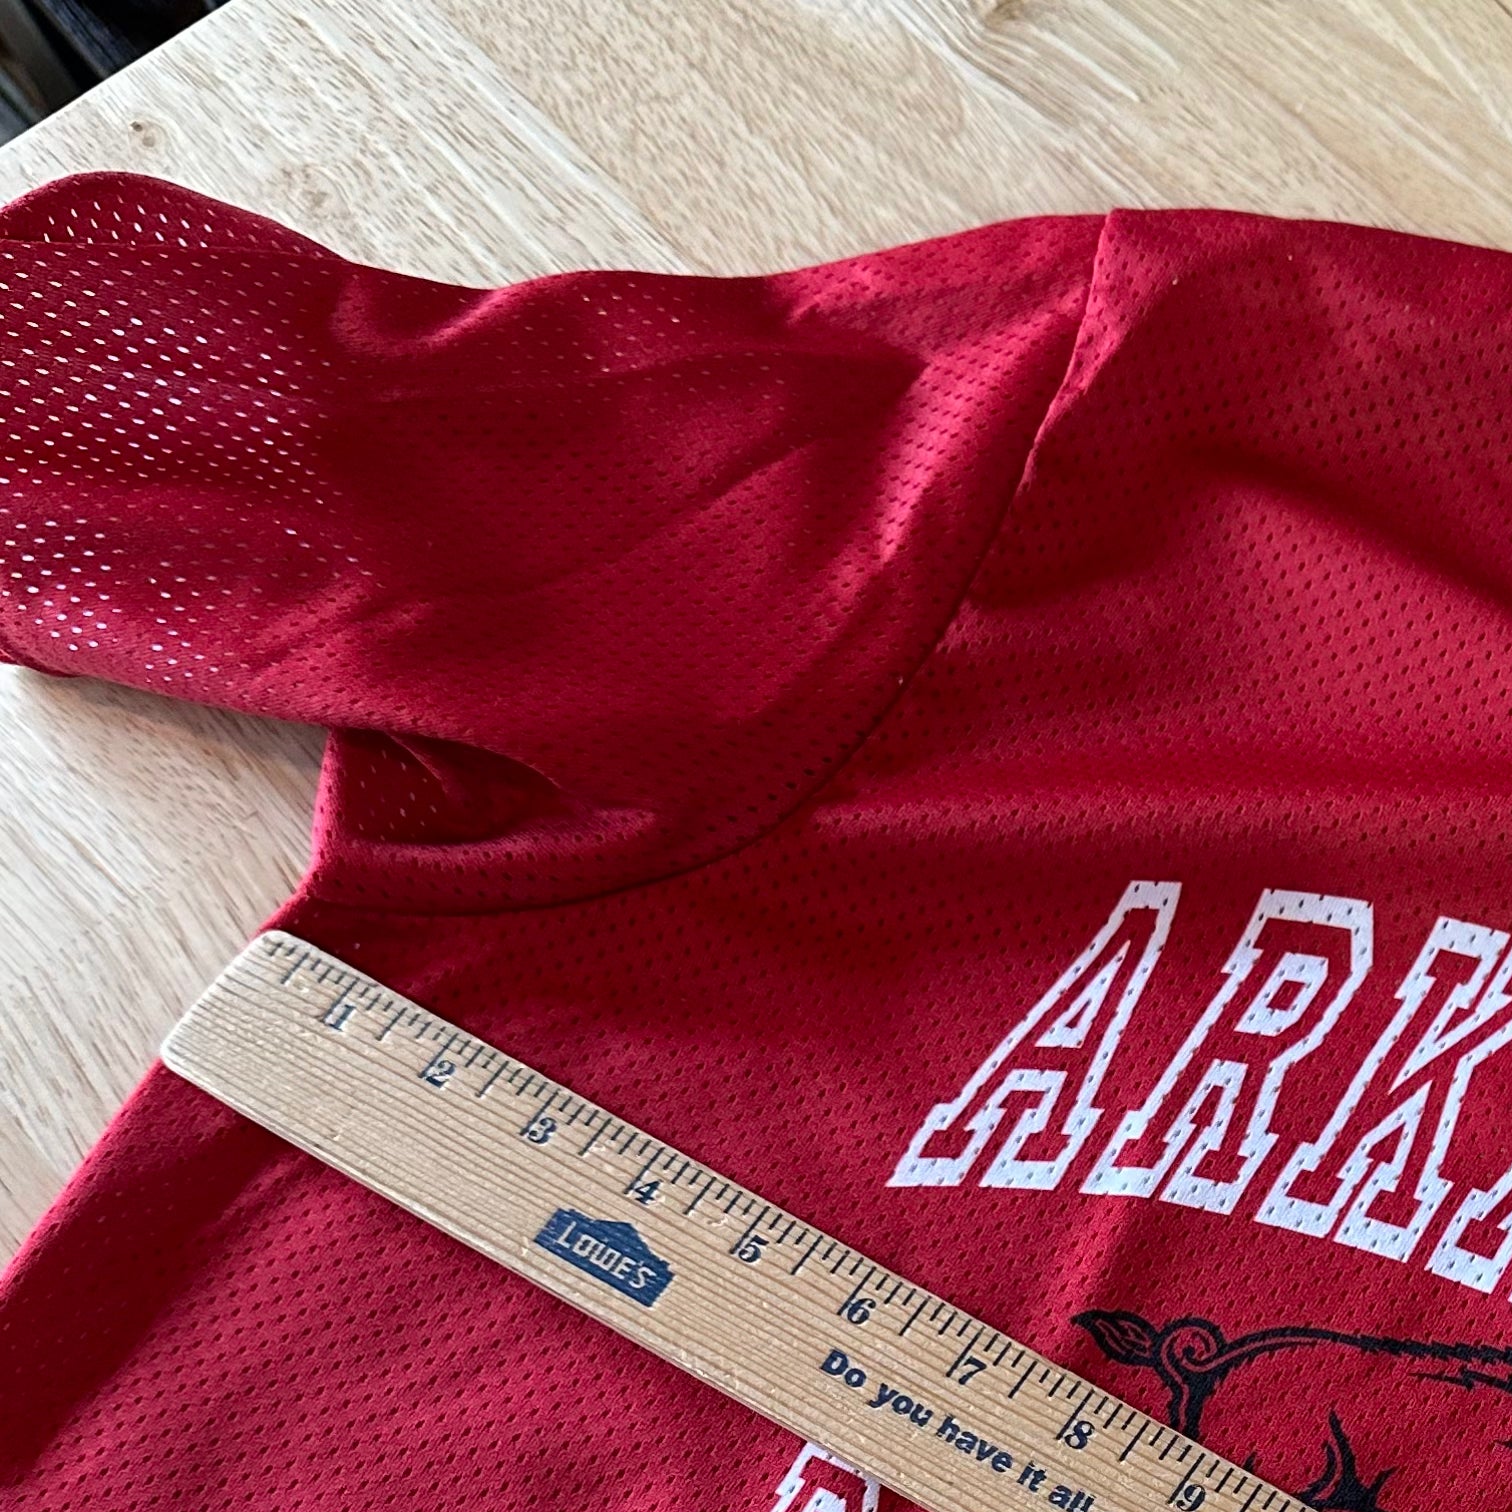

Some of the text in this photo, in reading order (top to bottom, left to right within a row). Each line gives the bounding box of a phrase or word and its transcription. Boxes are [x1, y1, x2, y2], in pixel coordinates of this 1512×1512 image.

[426, 1059, 457, 1088] 2
[528, 1116, 558, 1145] 3
[632, 1180, 660, 1205] 4
[738, 1234, 769, 1264] 5
[846, 1297, 878, 1325] 6
[958, 1356, 988, 1385] 7
[1065, 1420, 1096, 1450] 8
[1180, 1483, 1207, 1512] 9
[554, 1220, 657, 1289] LOWE'S
[820, 1348, 867, 1389] Do
[868, 1380, 934, 1428] you
[935, 1414, 1014, 1474] have
[1016, 1460, 1049, 1493] it
